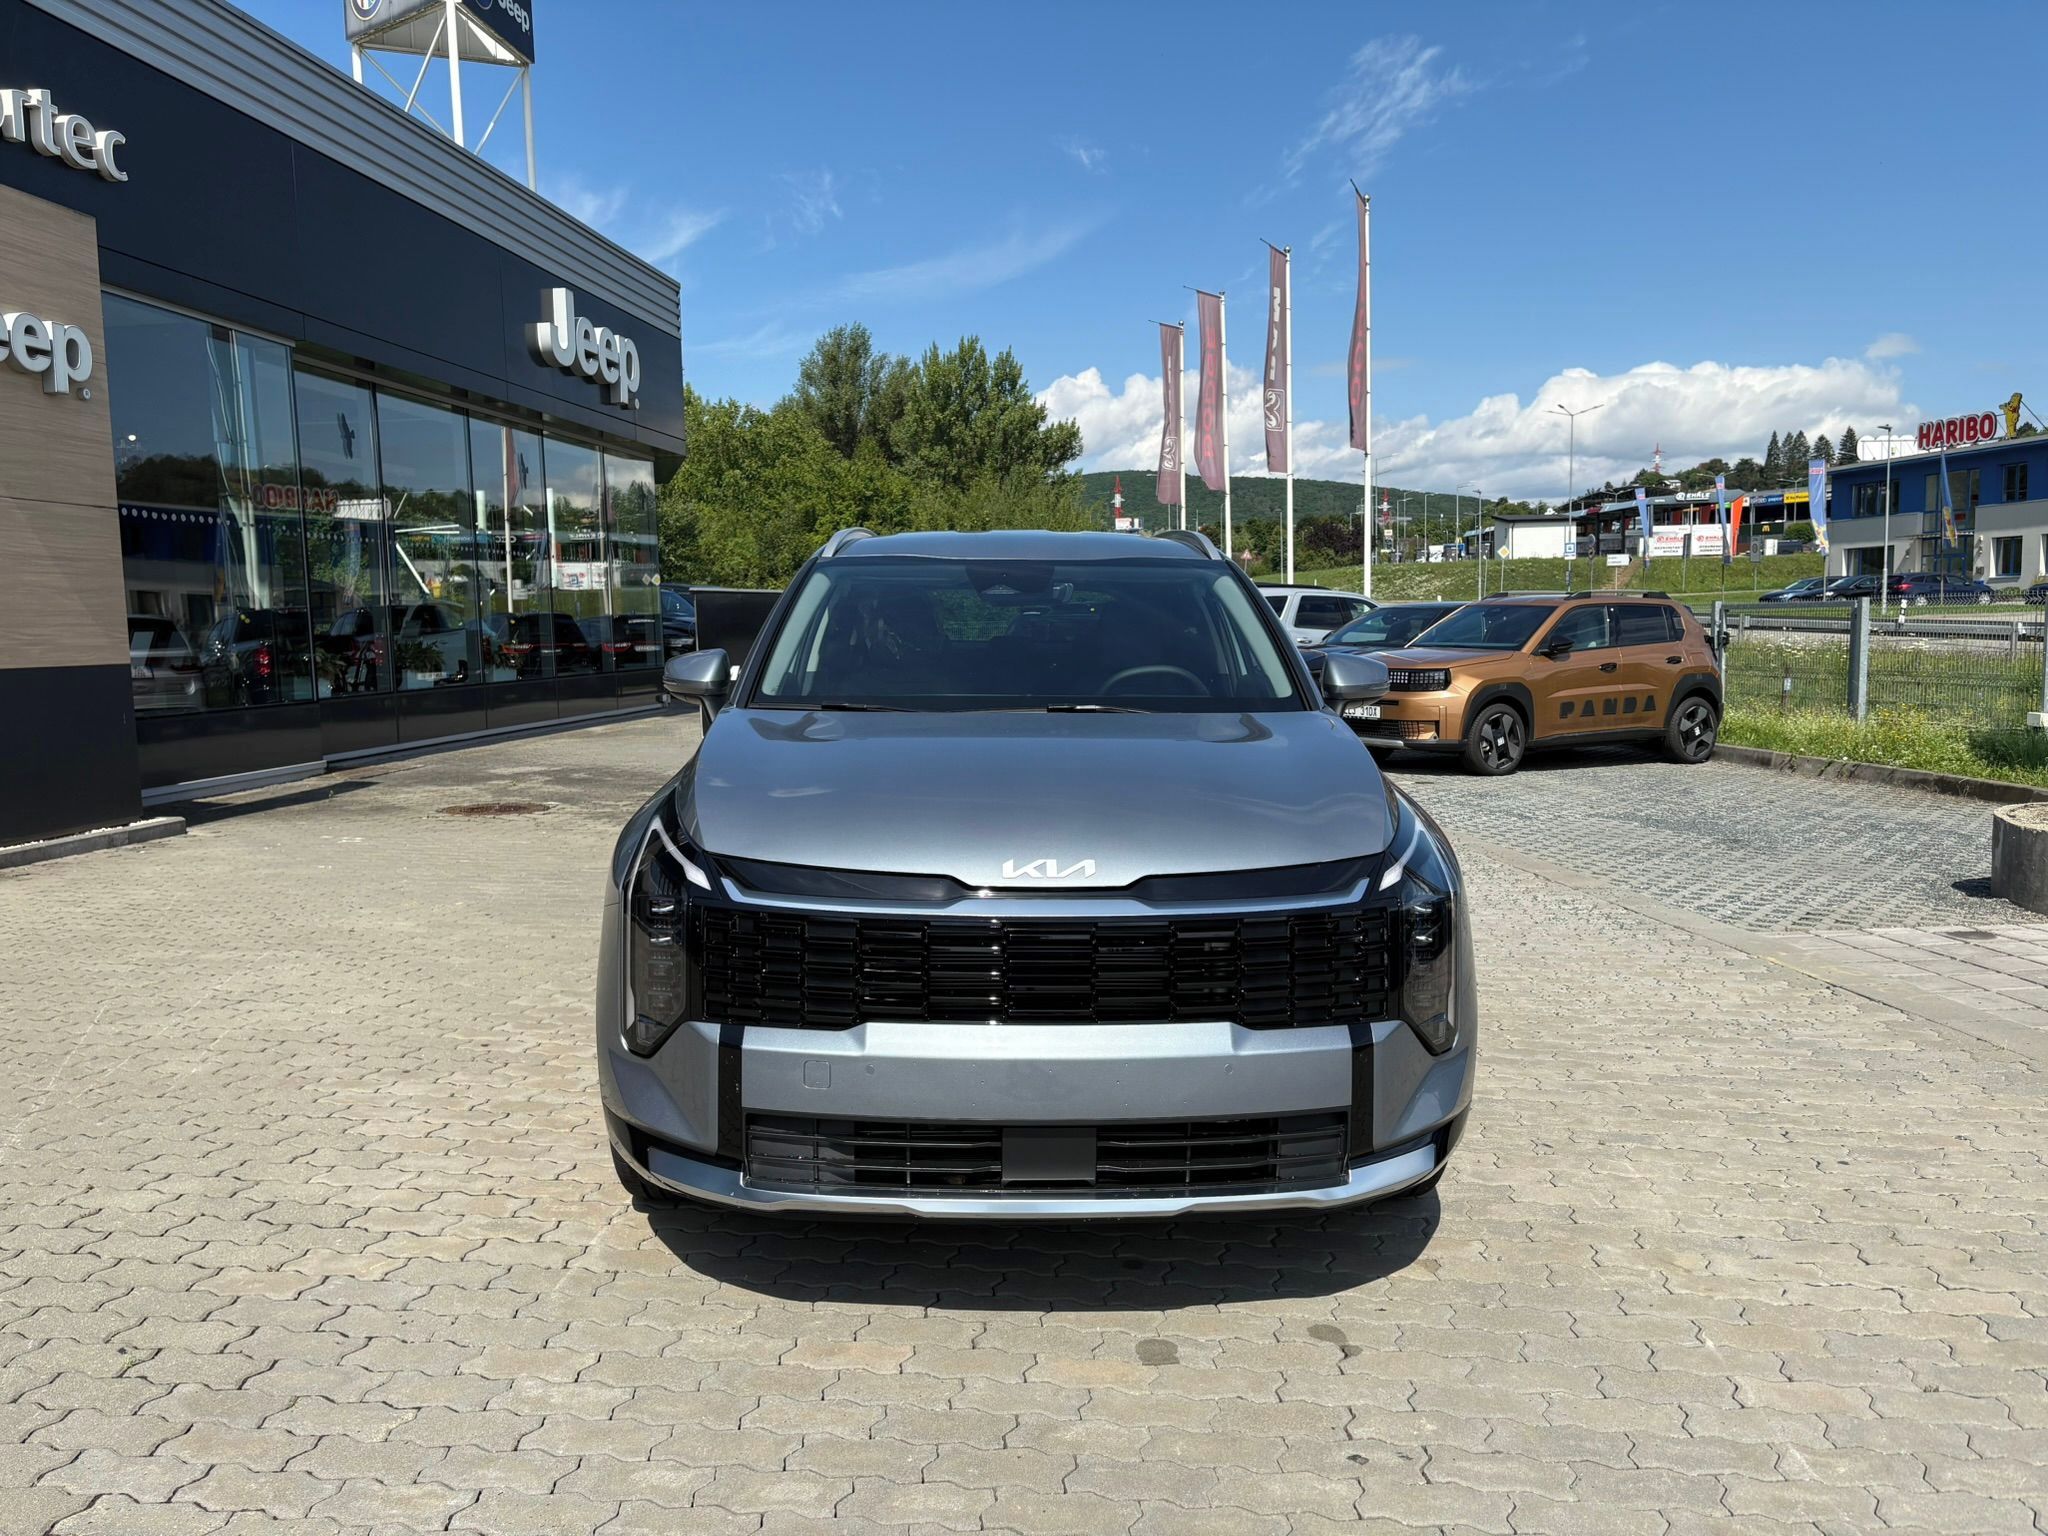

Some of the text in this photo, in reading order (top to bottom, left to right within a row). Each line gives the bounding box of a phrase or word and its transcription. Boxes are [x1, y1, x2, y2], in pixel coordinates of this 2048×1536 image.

[536, 287, 641, 405] Jeep
[1917, 411, 1998, 451] HARIBO
[1559, 695, 1657, 719] PANDA
[1002, 858, 1096, 879] KIA
